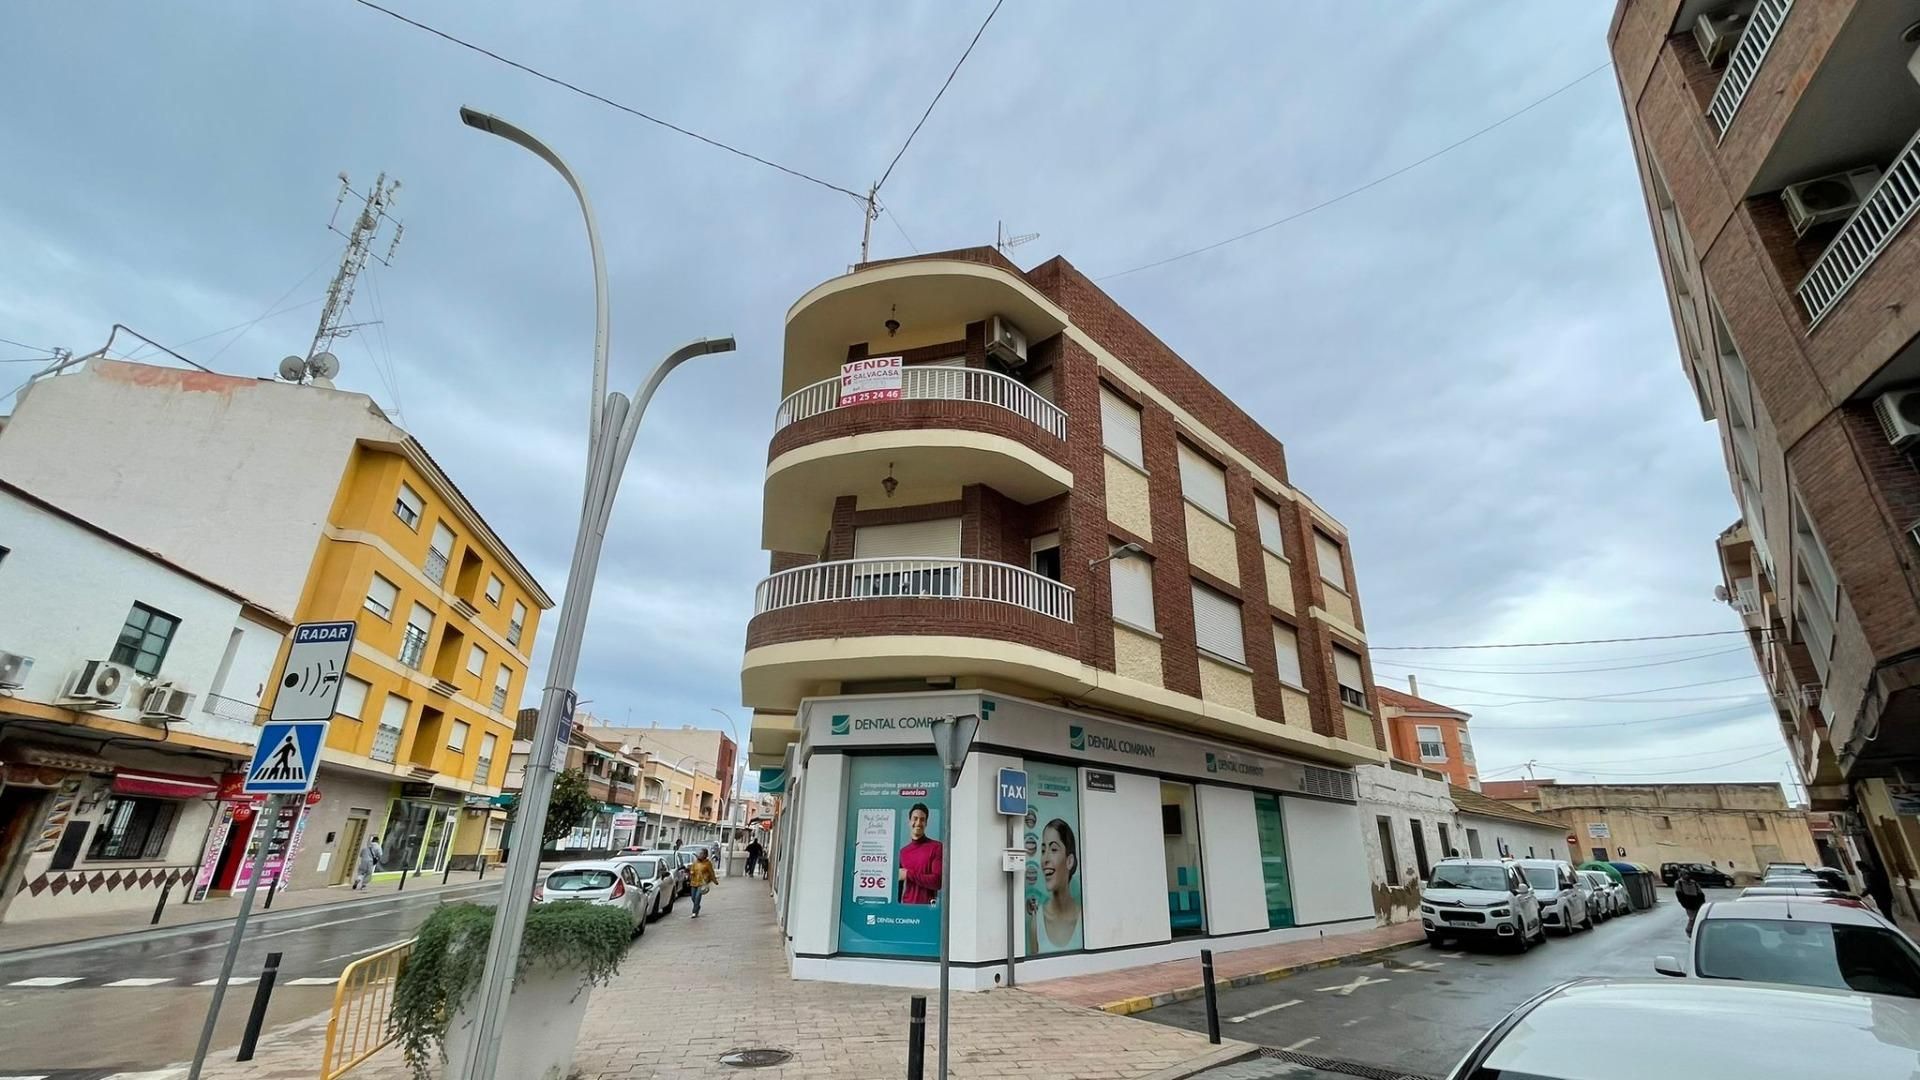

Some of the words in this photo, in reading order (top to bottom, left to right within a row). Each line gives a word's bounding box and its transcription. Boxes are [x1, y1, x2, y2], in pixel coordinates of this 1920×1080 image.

[843, 359, 900, 373] VENDE
[853, 370, 899, 379] SALVACASA
[842, 396, 856, 404] 621
[872, 391, 884, 399] 24
[886, 390, 899, 398] 46
[300, 627, 348, 640] RADAR
[855, 717, 896, 730] DENTAL
[898, 716, 947, 729] COMP
[1087, 734, 1118, 751] DENTAL
[1119, 740, 1155, 757] COMPANY
[1001, 784, 1026, 799] TAXI
[861, 855, 888, 863] GRATIS
[860, 876, 886, 889] 39€
[895, 917, 921, 925] COMPANY
